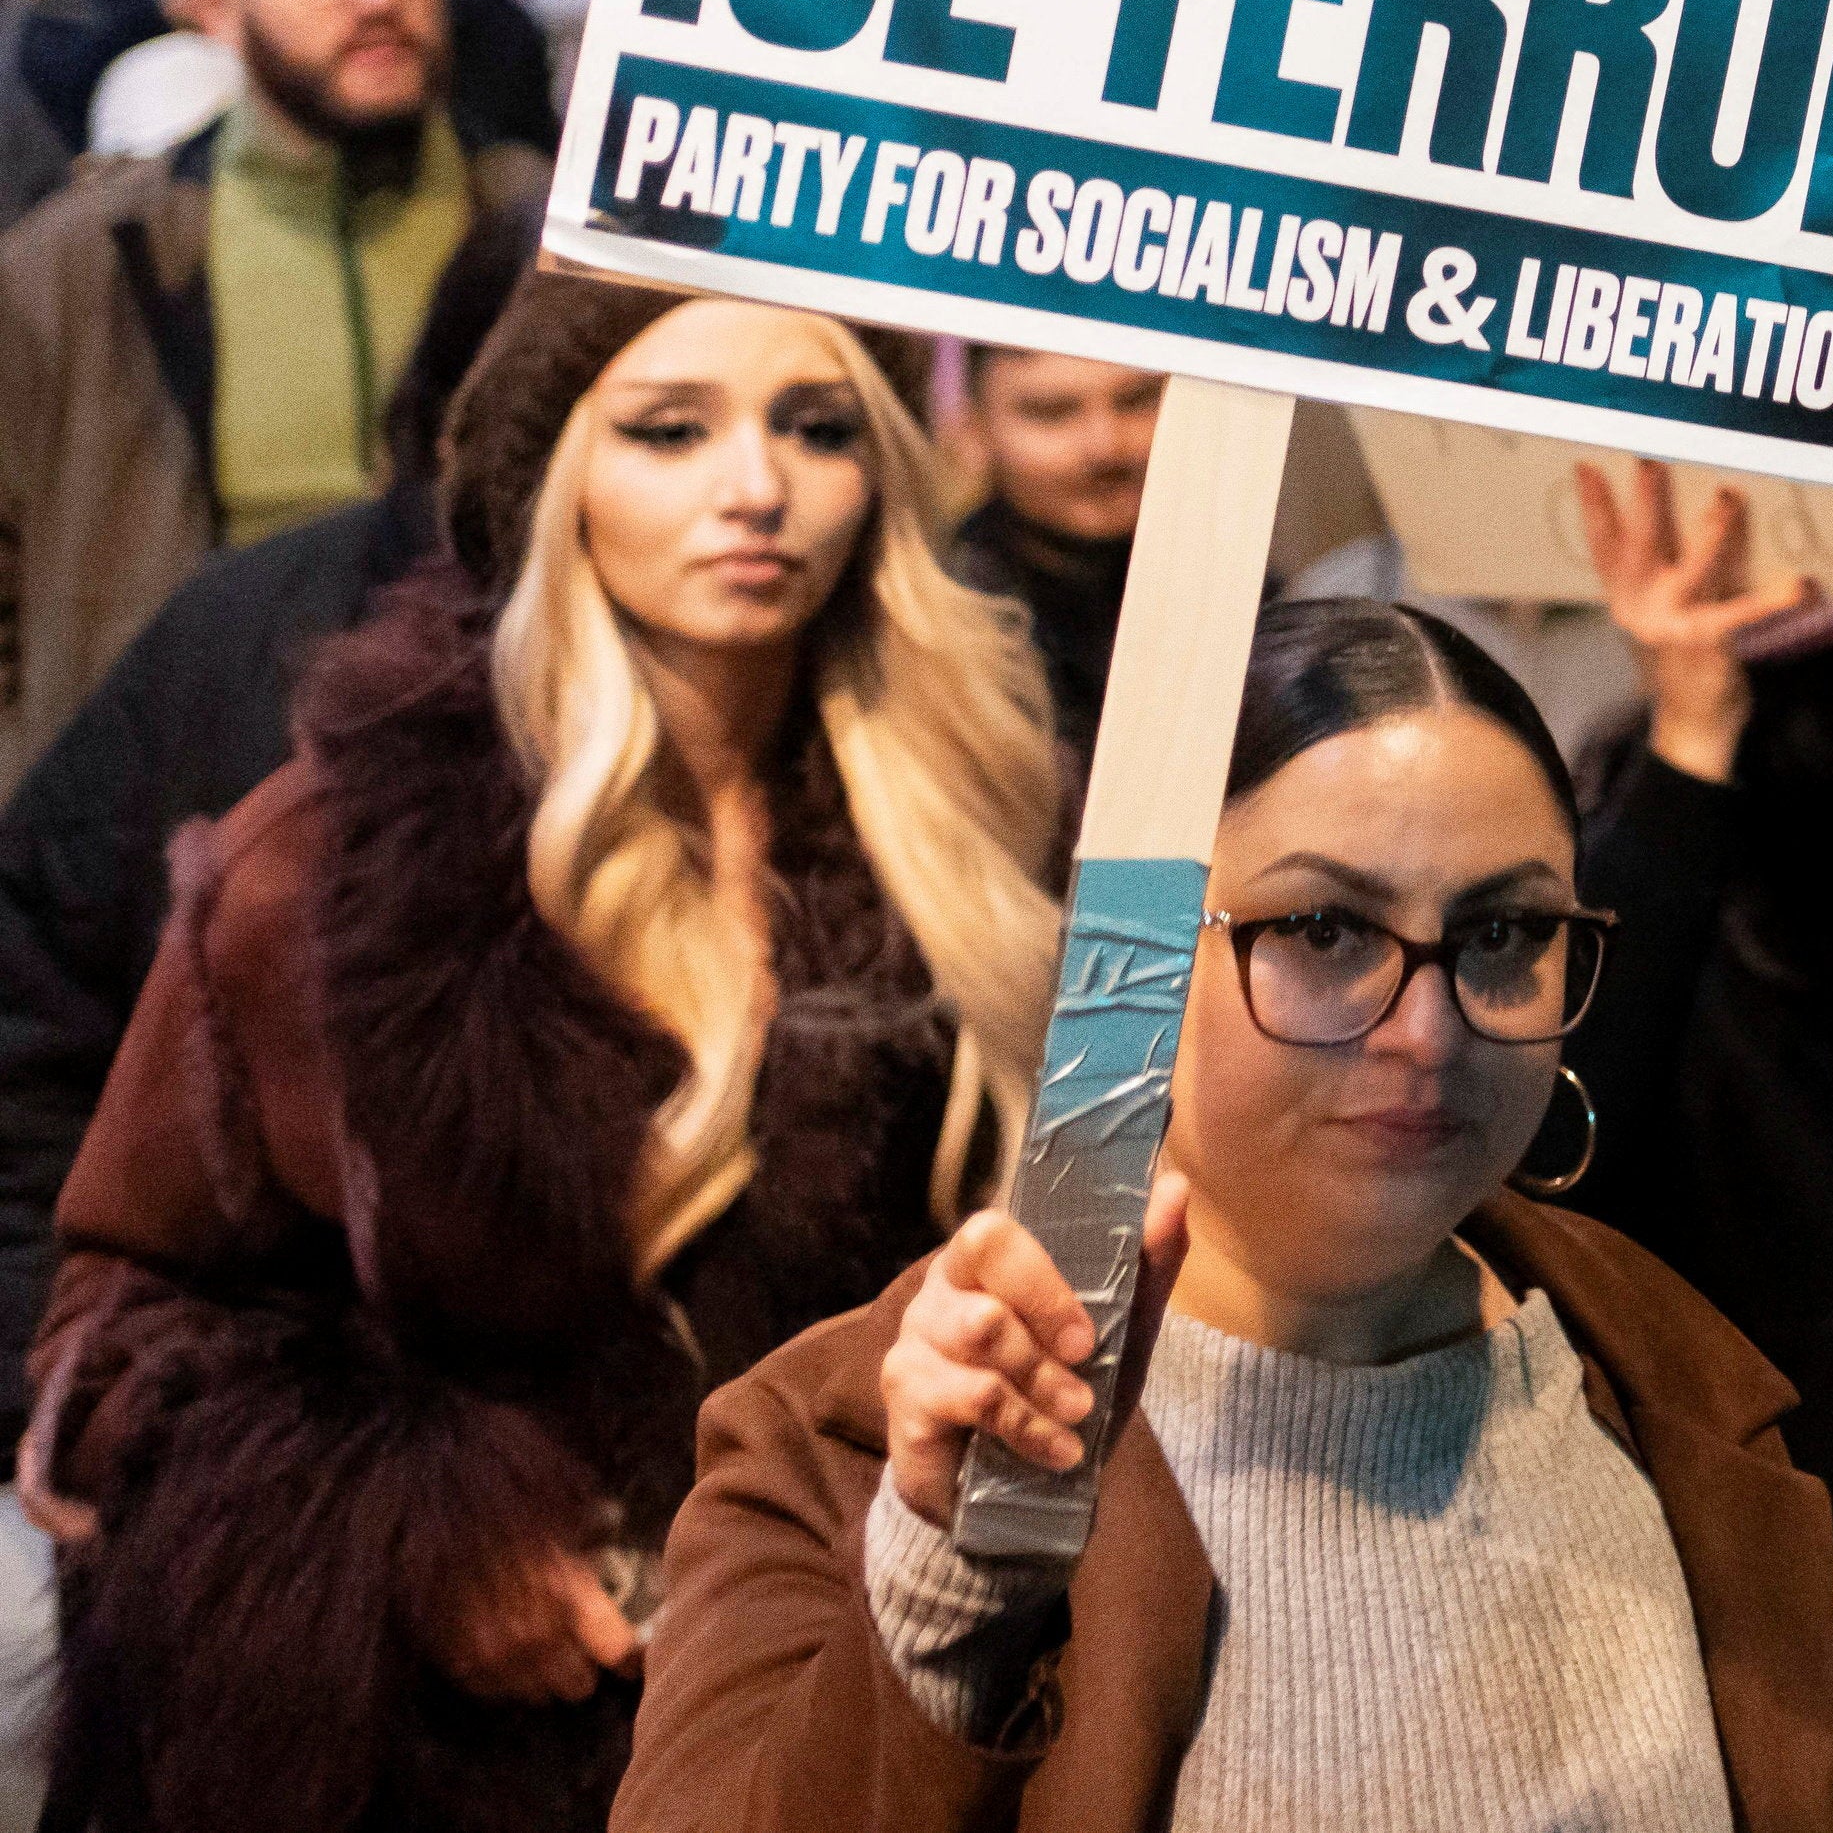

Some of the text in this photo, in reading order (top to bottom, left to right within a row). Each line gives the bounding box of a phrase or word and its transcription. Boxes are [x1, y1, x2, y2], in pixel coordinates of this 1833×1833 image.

[615, 96, 866, 237] PARTY
[858, 147, 1013, 263] FOR
[1016, 175, 1402, 332] SOCIALISM
[1406, 247, 1492, 353] &
